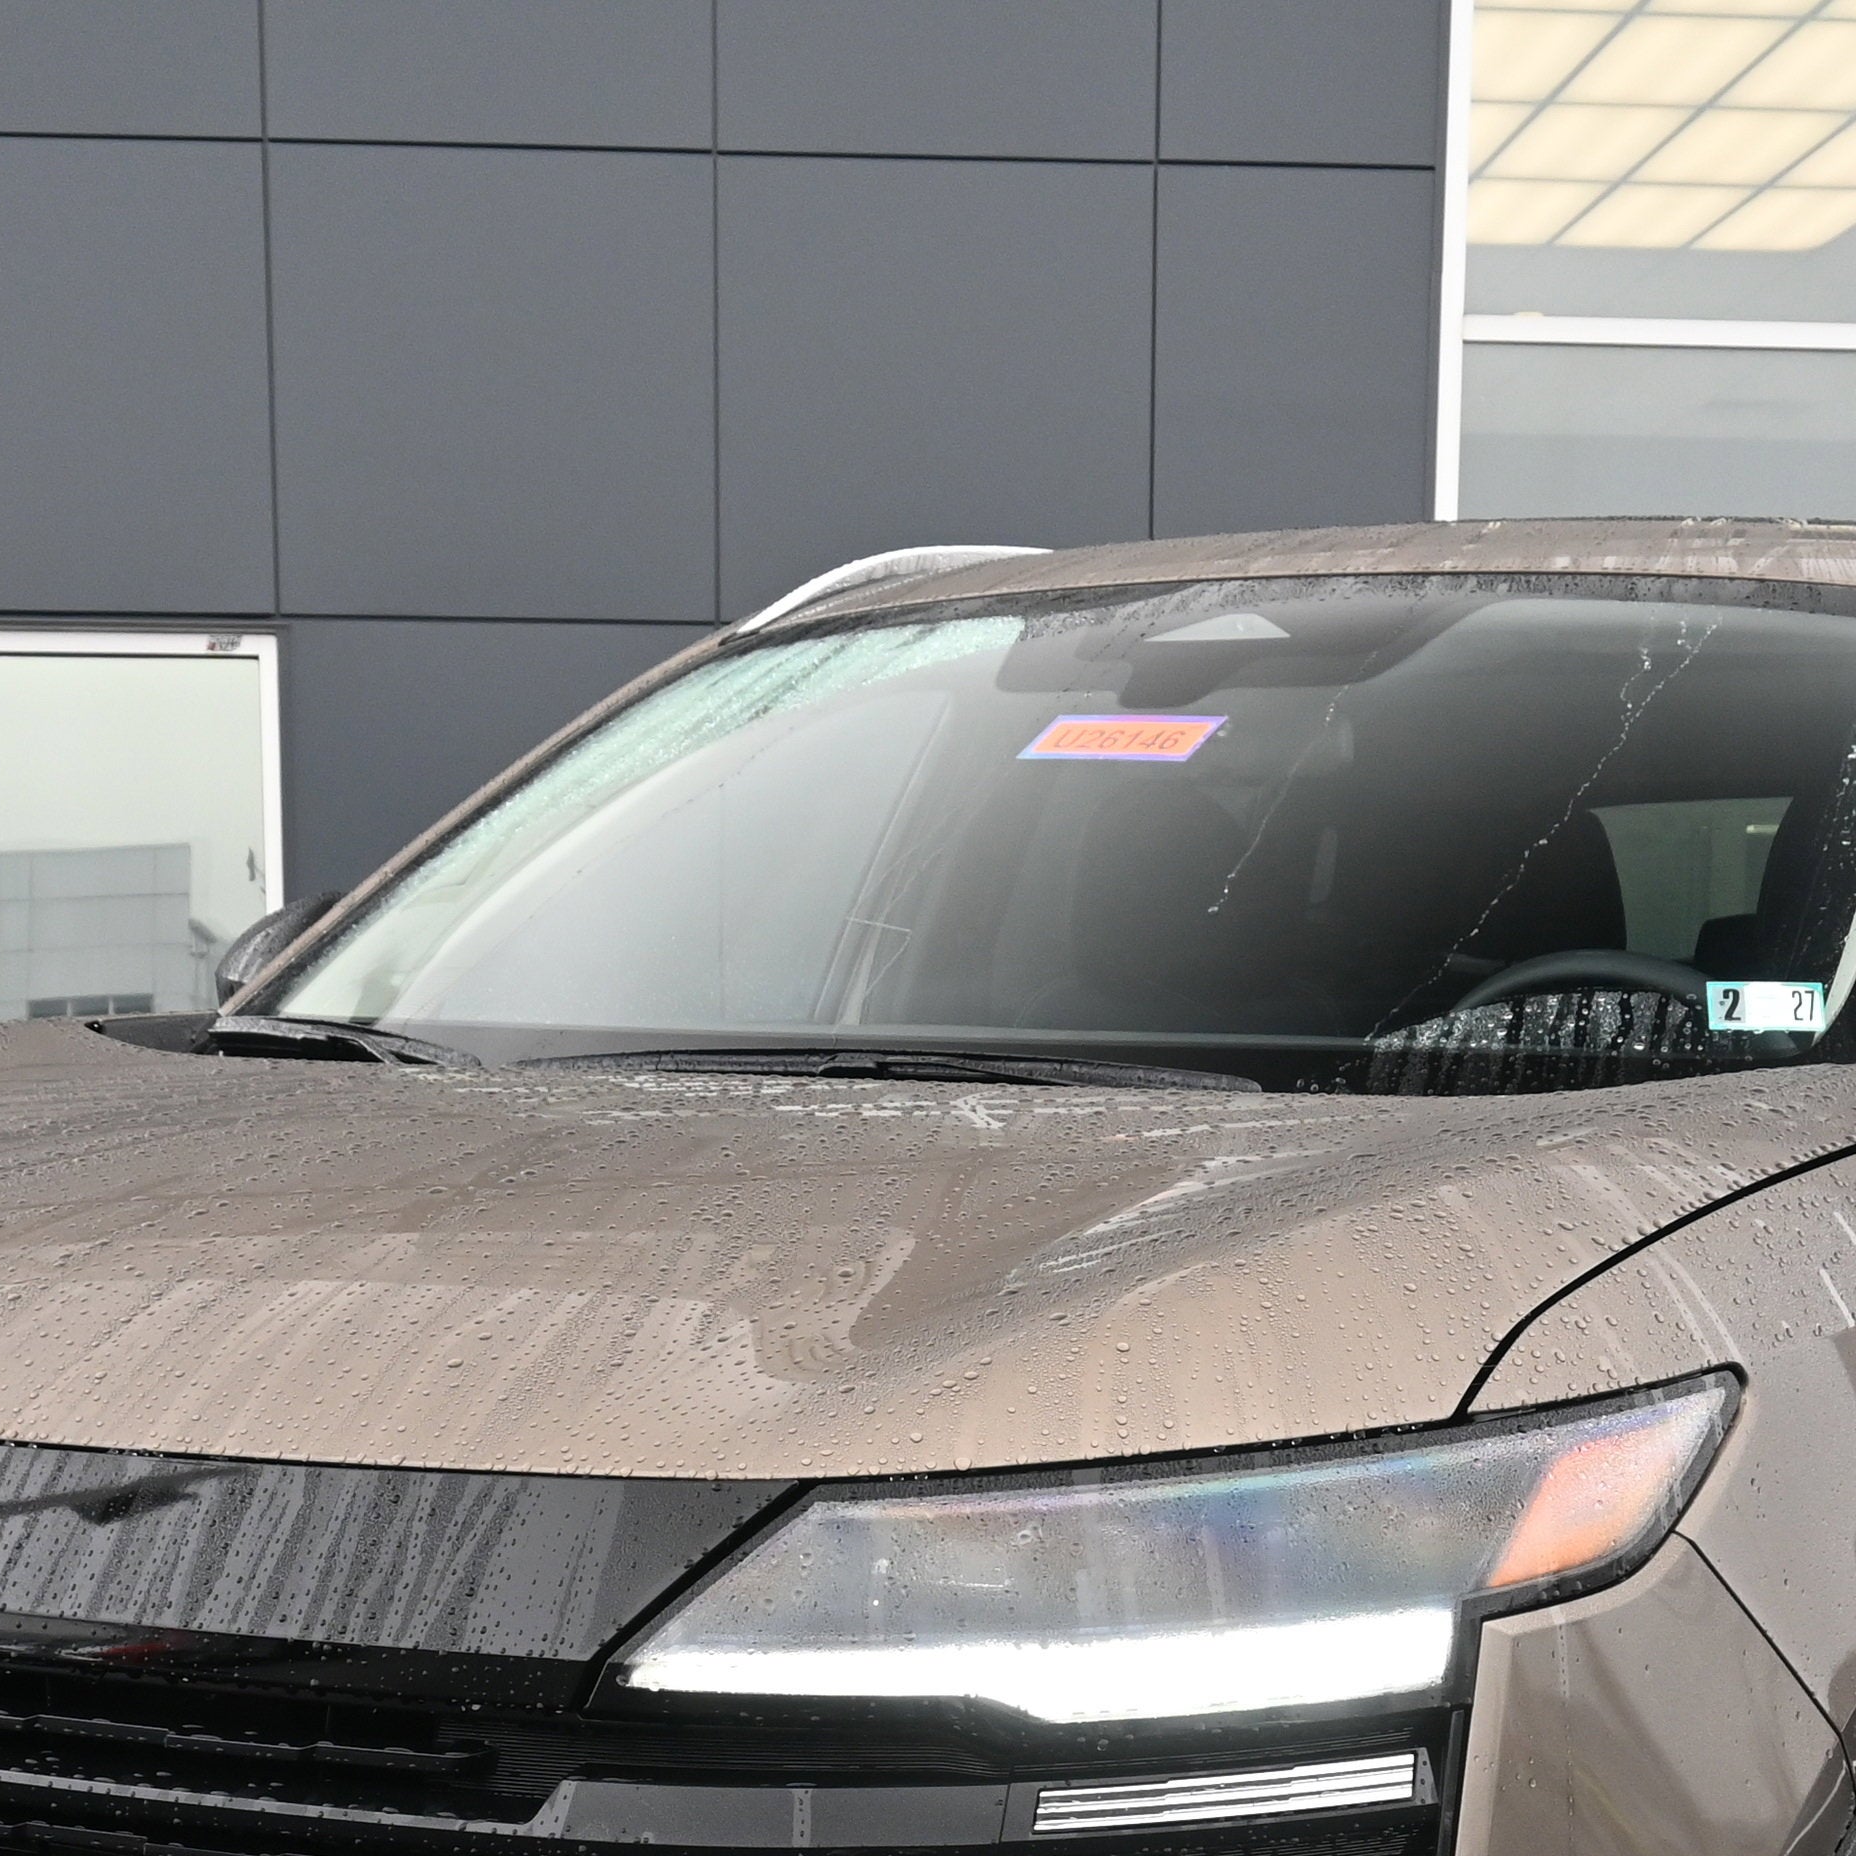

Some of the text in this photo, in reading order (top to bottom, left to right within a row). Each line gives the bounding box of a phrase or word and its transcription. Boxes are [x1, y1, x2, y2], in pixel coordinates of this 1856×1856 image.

[1052, 729, 1187, 751] U26146
[1722, 988, 1815, 1022] 2 27
